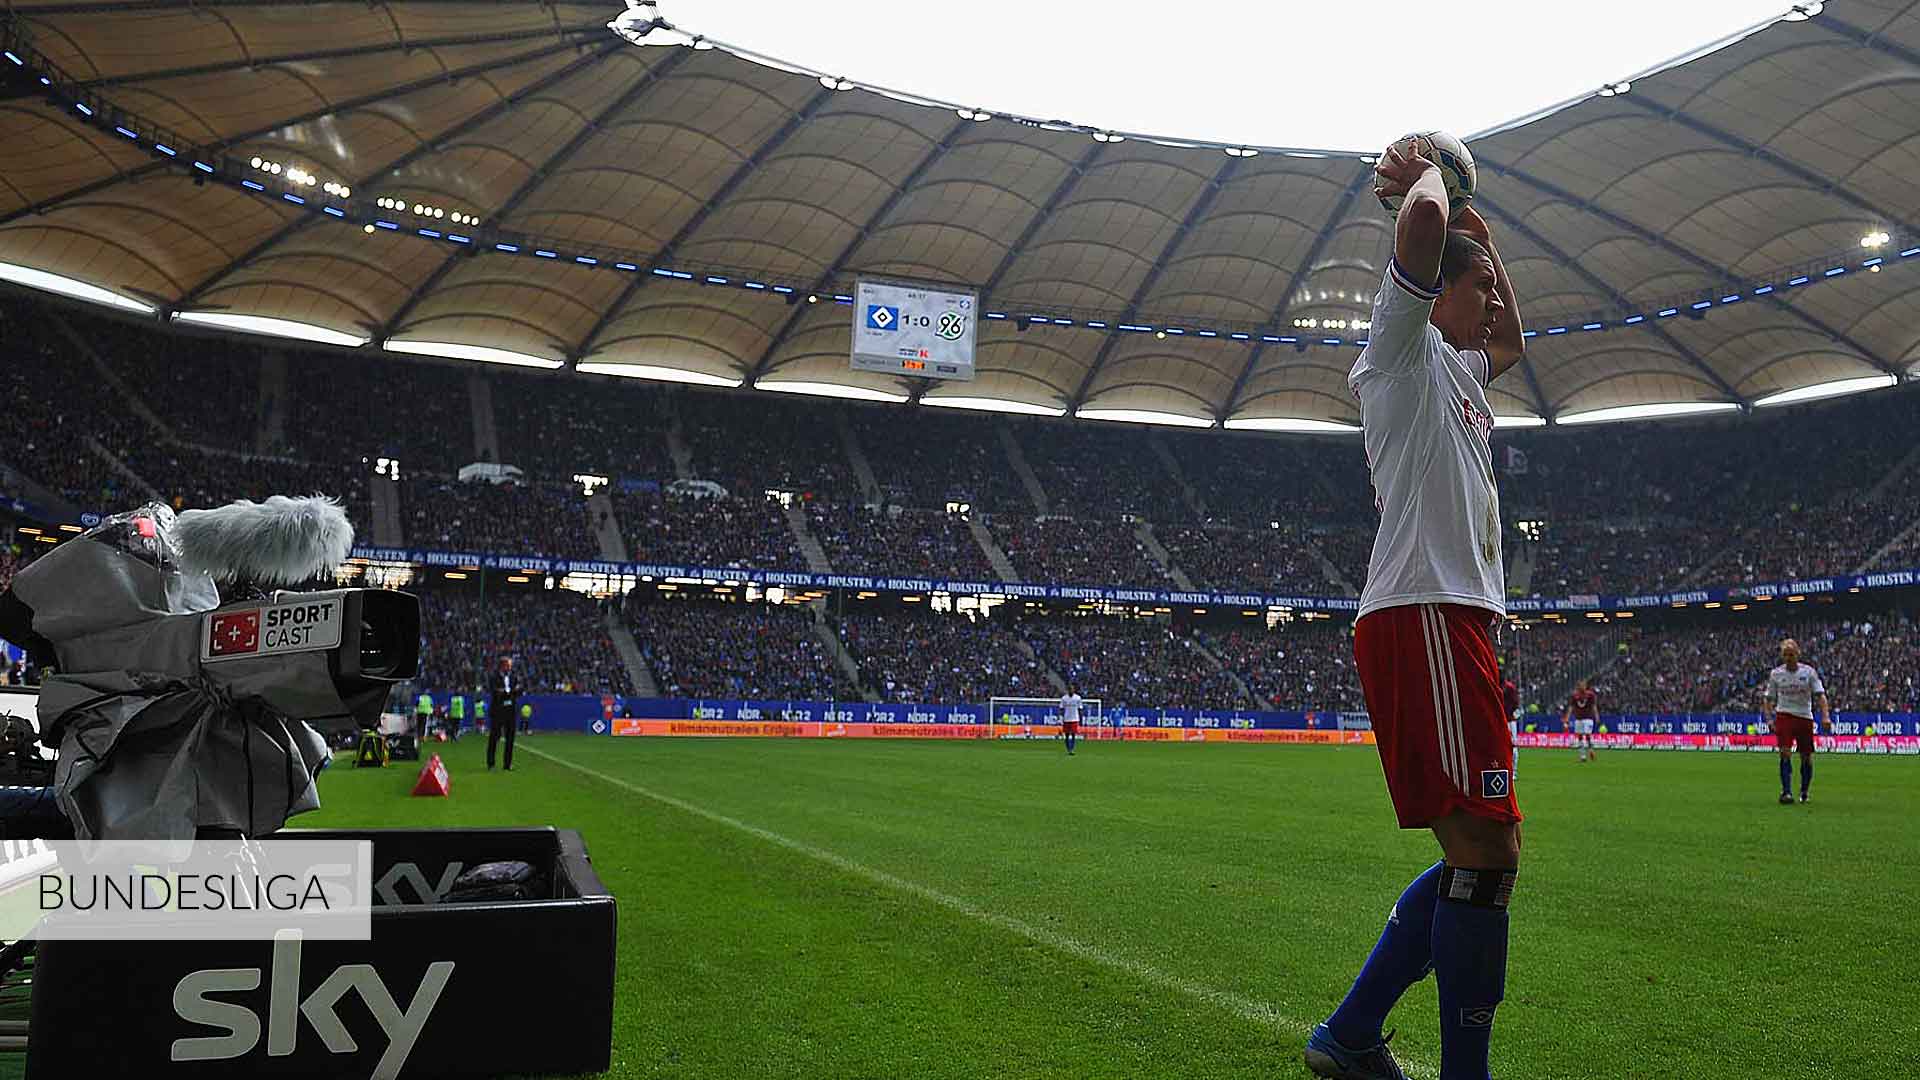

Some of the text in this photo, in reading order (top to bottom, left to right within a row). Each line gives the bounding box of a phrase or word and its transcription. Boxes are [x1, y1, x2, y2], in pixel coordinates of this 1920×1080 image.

[902, 314, 930, 327] 1:0
[352, 548, 407, 561] HOLSTEN
[427, 552, 480, 566] HOLSTEN
[499, 556, 550, 570] HOLSTEN
[569, 560, 619, 573] HOLSTEN
[637, 564, 685, 577] HOLSTEN
[703, 568, 749, 581] HOLSTEN
[766, 572, 812, 585] HOLSTEN
[828, 576, 873, 588] HOLSTEN
[888, 579, 931, 591] HOLSTEN
[948, 581, 990, 593] HOLSTEN
[1005, 584, 1046, 597] HOLSTEN
[1061, 587, 1101, 599] HOLSTEN
[1116, 590, 1156, 602] HOLSTEN
[1170, 592, 1210, 603] HOLSTEN
[1224, 595, 1262, 606] HOLSTEN
[1276, 597, 1314, 608] HOLSTEN
[1792, 580, 1834, 593] HOLSTEN
[1868, 572, 1913, 587] HOLSTEN
[1505, 600, 1540, 610] OLSTEN
[267, 603, 333, 628] SPORT
[265, 626, 313, 648] CAST
[171, 928, 455, 1080] sky
